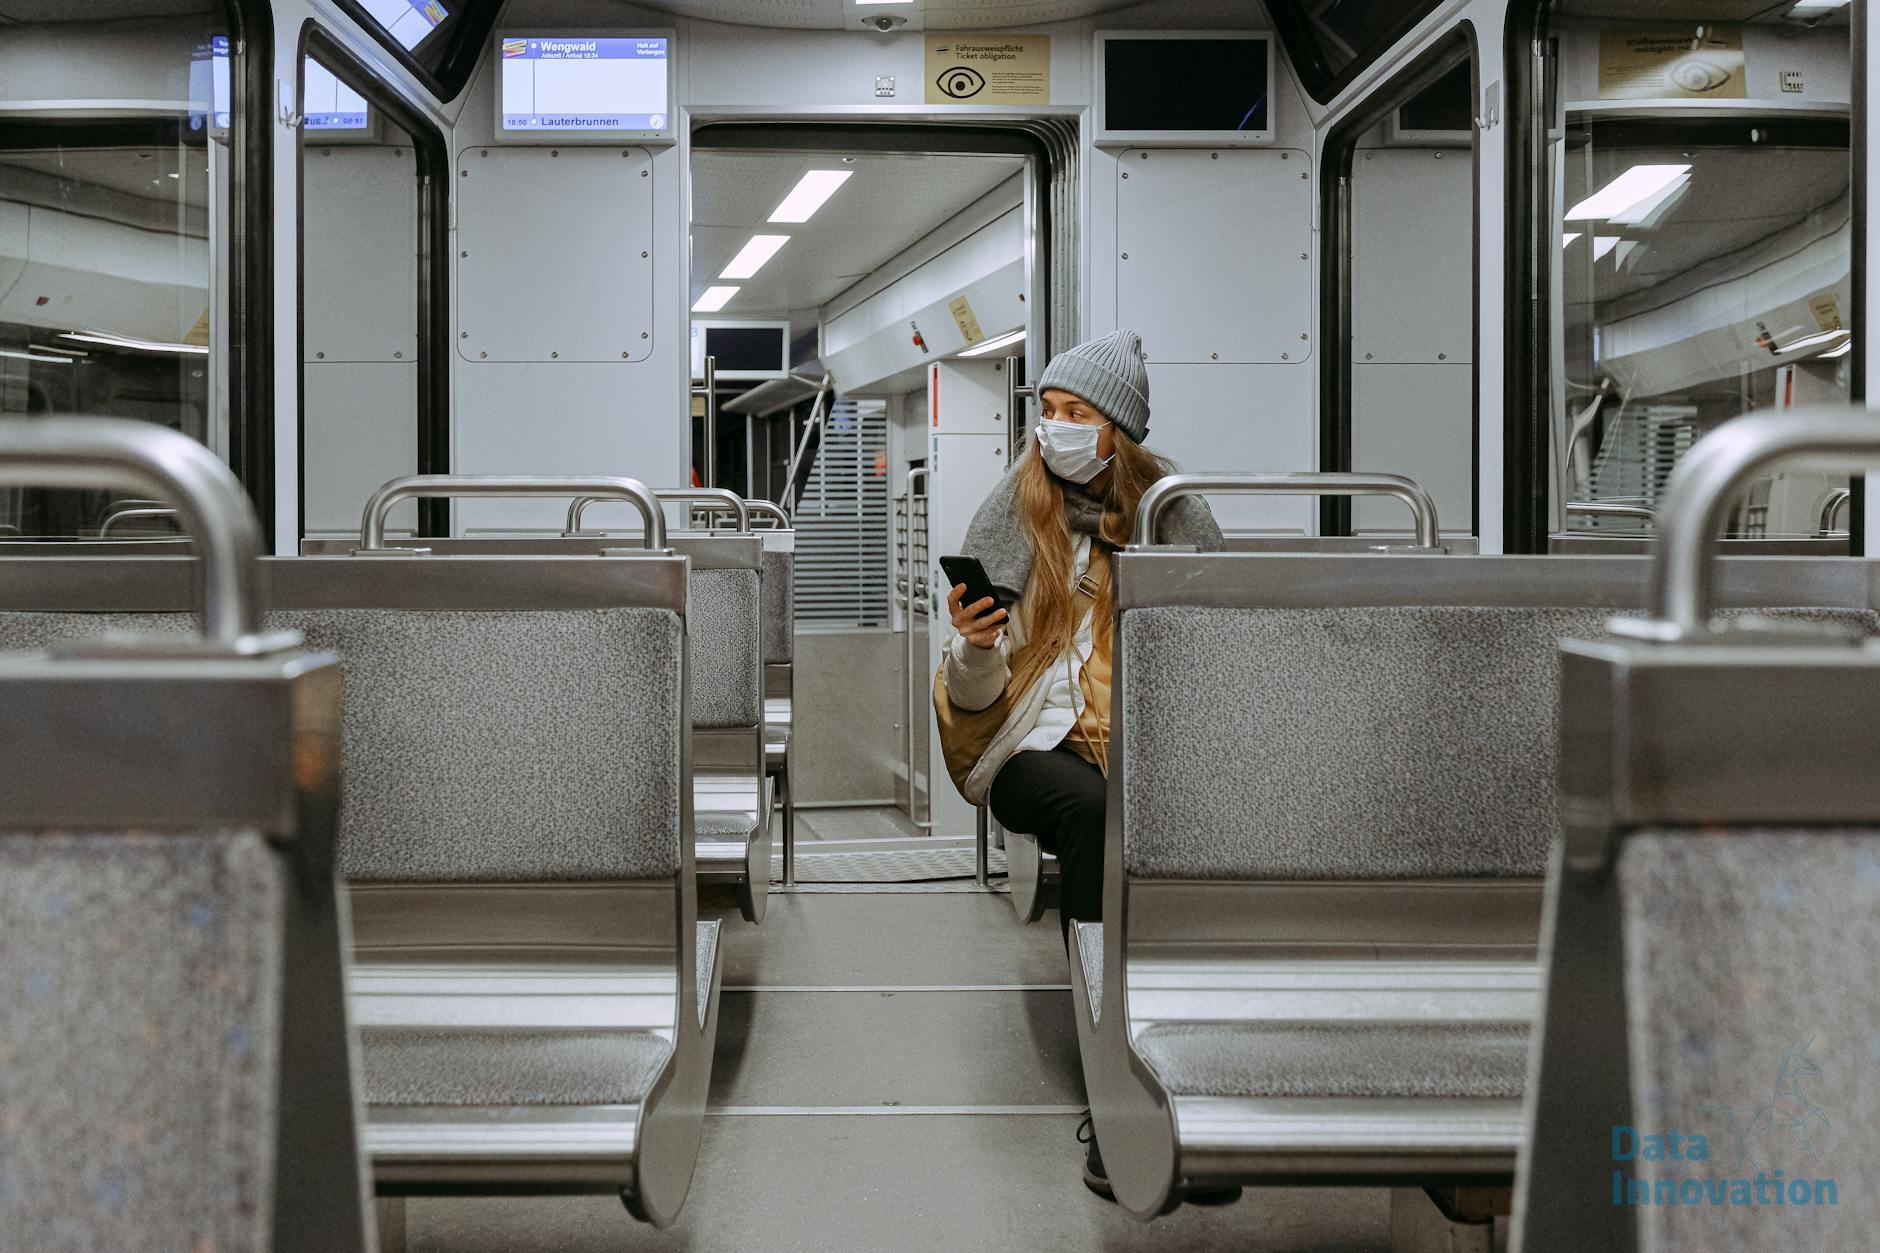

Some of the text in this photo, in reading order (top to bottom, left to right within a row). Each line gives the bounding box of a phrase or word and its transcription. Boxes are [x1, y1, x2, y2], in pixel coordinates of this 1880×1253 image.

[541, 41, 596, 52] Wengwald
[955, 44, 1024, 53] Fahrausweispflicht
[980, 52, 1016, 61] obligation
[541, 117, 619, 126] Lauterbrunnen
